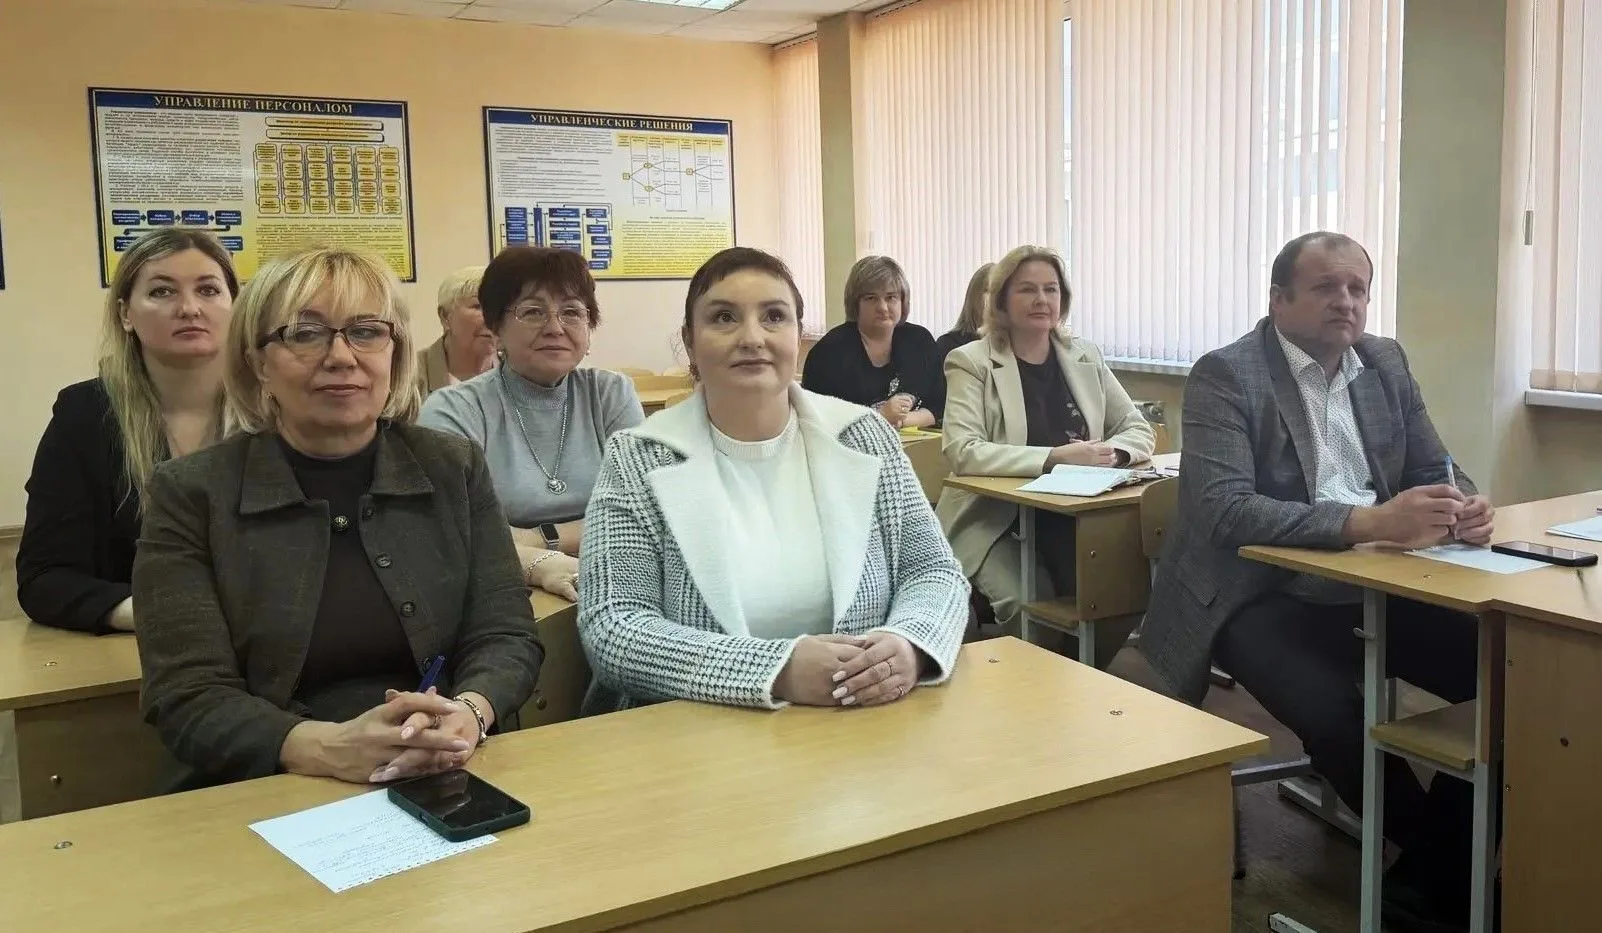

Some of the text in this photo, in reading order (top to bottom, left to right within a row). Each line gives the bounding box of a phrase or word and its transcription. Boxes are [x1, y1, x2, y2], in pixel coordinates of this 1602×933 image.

[153, 95, 353, 114] УПРАВЛЕНИЕ ПЕРСОНАЛОМ
[530, 113, 694, 131] УПРАВЛЕНЧЕСКИЕ РЕШЕНИЯ
